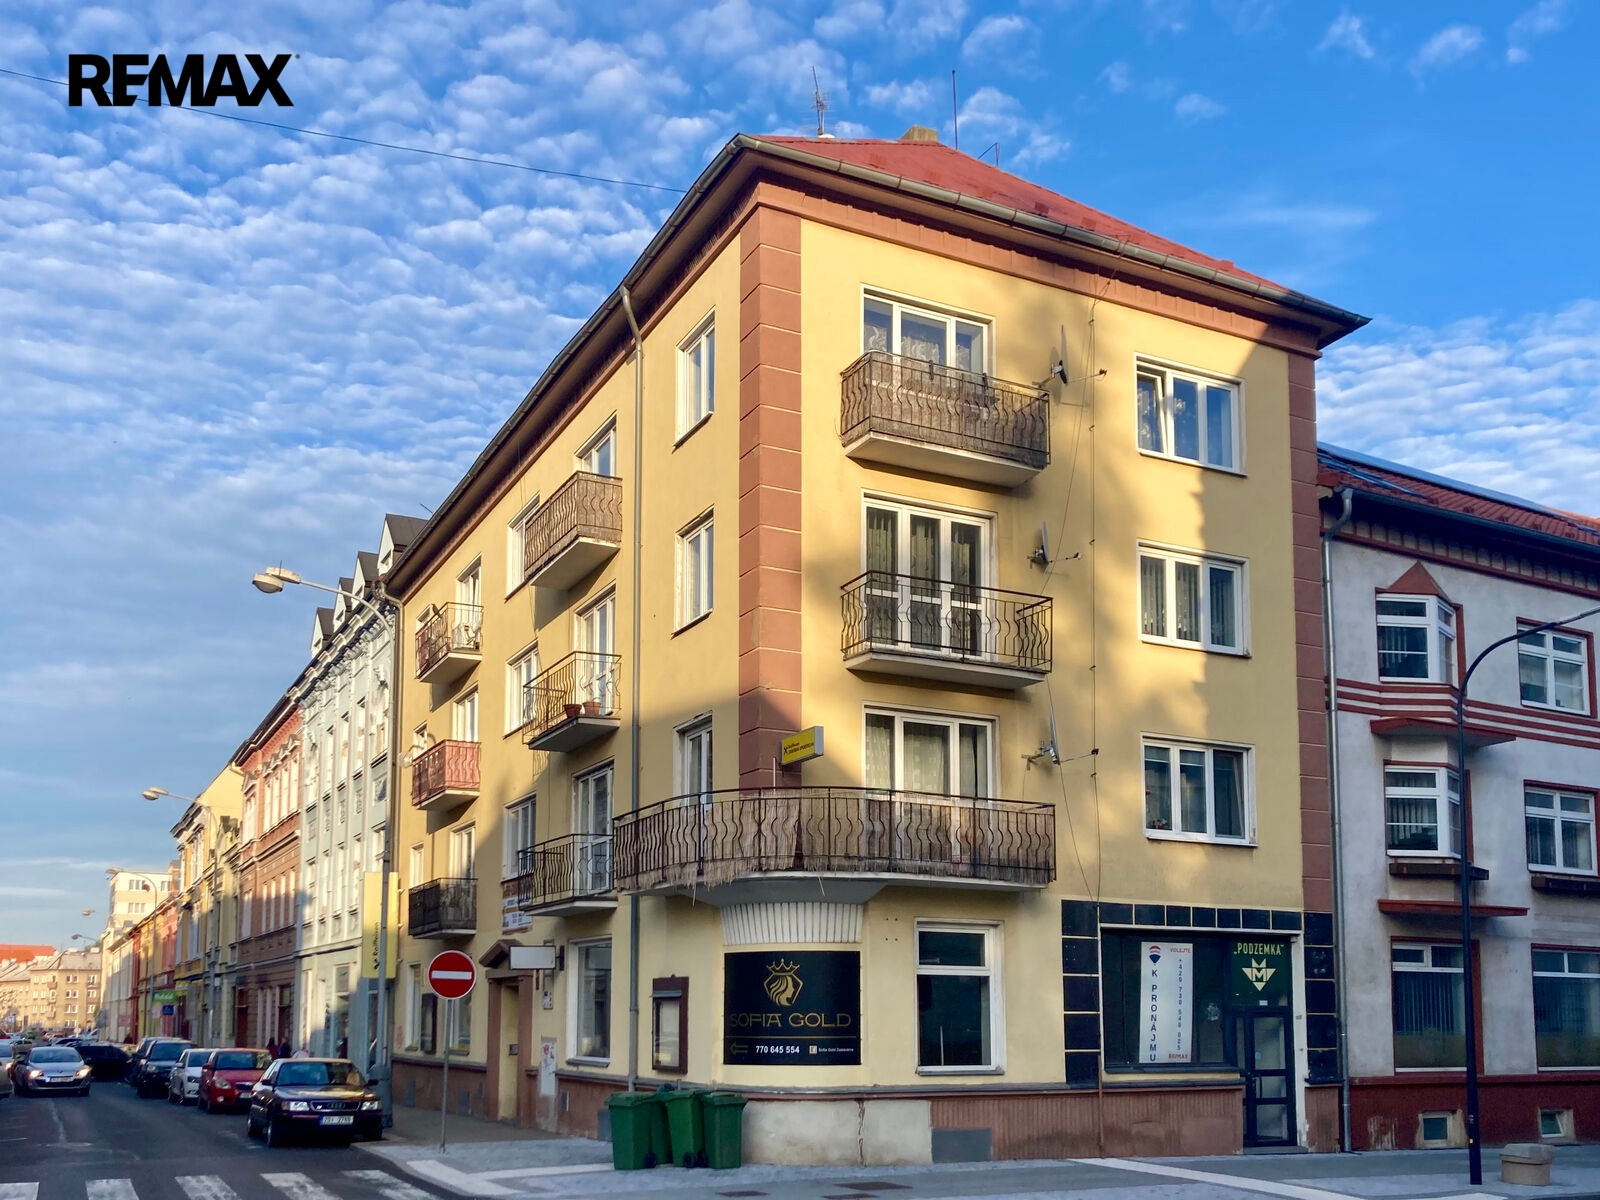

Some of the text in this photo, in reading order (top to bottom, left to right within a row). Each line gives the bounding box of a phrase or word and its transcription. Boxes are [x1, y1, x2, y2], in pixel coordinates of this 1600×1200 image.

[1152, 969, 1158, 977] K
[729, 1012, 851, 1027] SOFIA GOLD
[755, 1045, 800, 1054] 770 645 554
